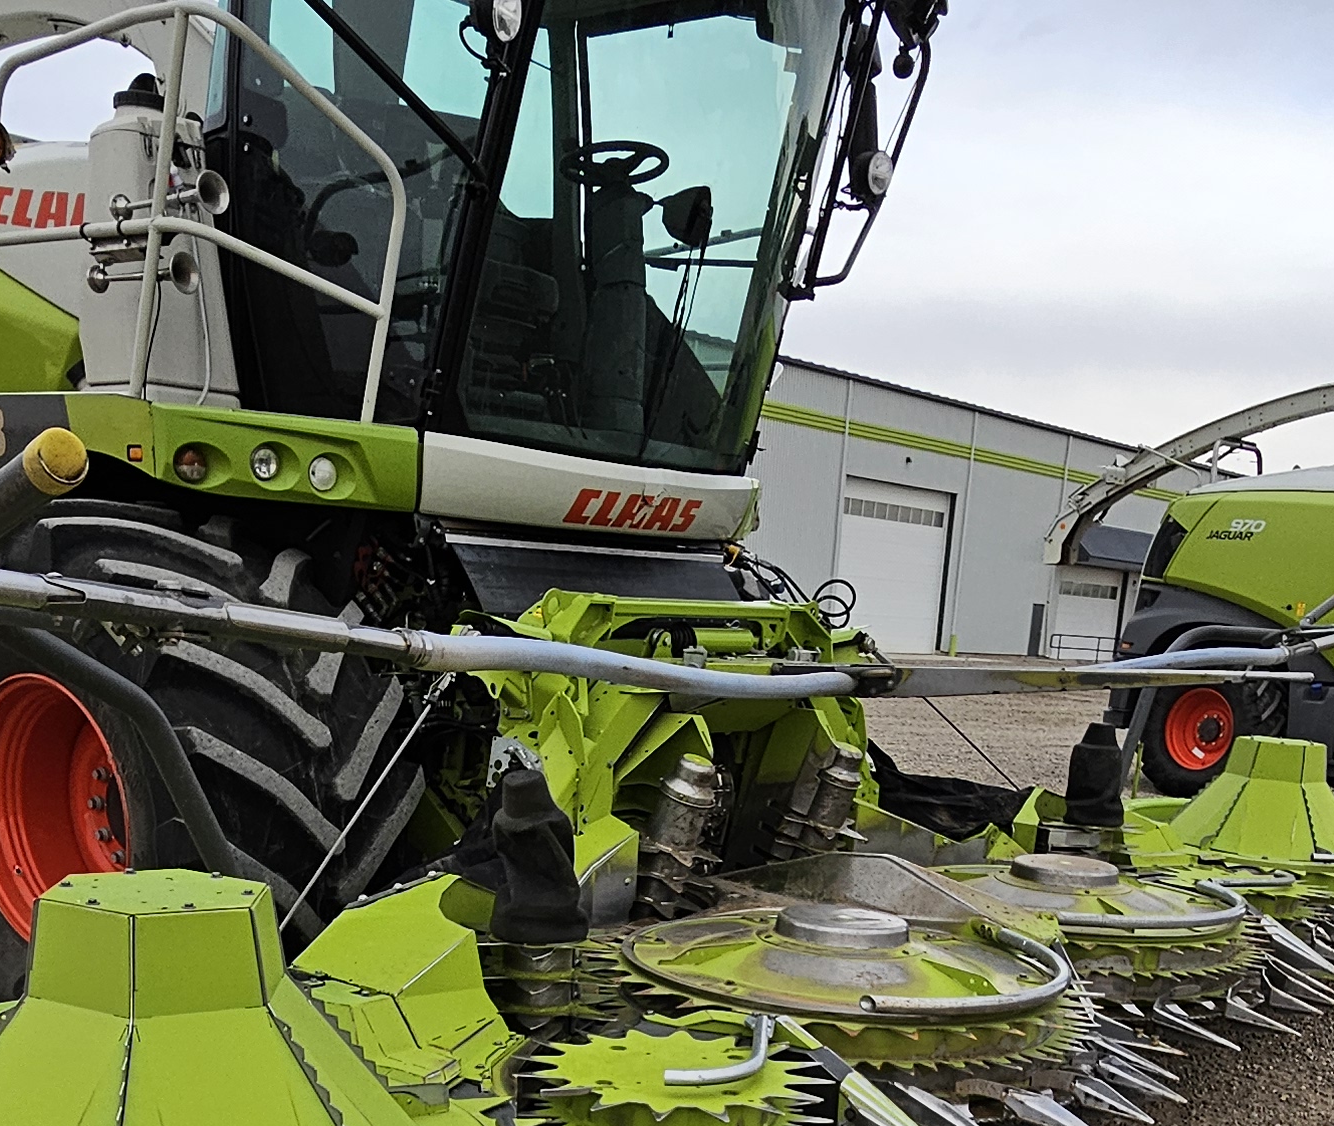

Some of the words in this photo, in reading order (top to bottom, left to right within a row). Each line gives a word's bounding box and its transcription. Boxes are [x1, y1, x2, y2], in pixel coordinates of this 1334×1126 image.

[562, 488, 703, 532] CLAAS
[1229, 519, 1266, 533] 970
[1206, 530, 1254, 541] JAGUAR
